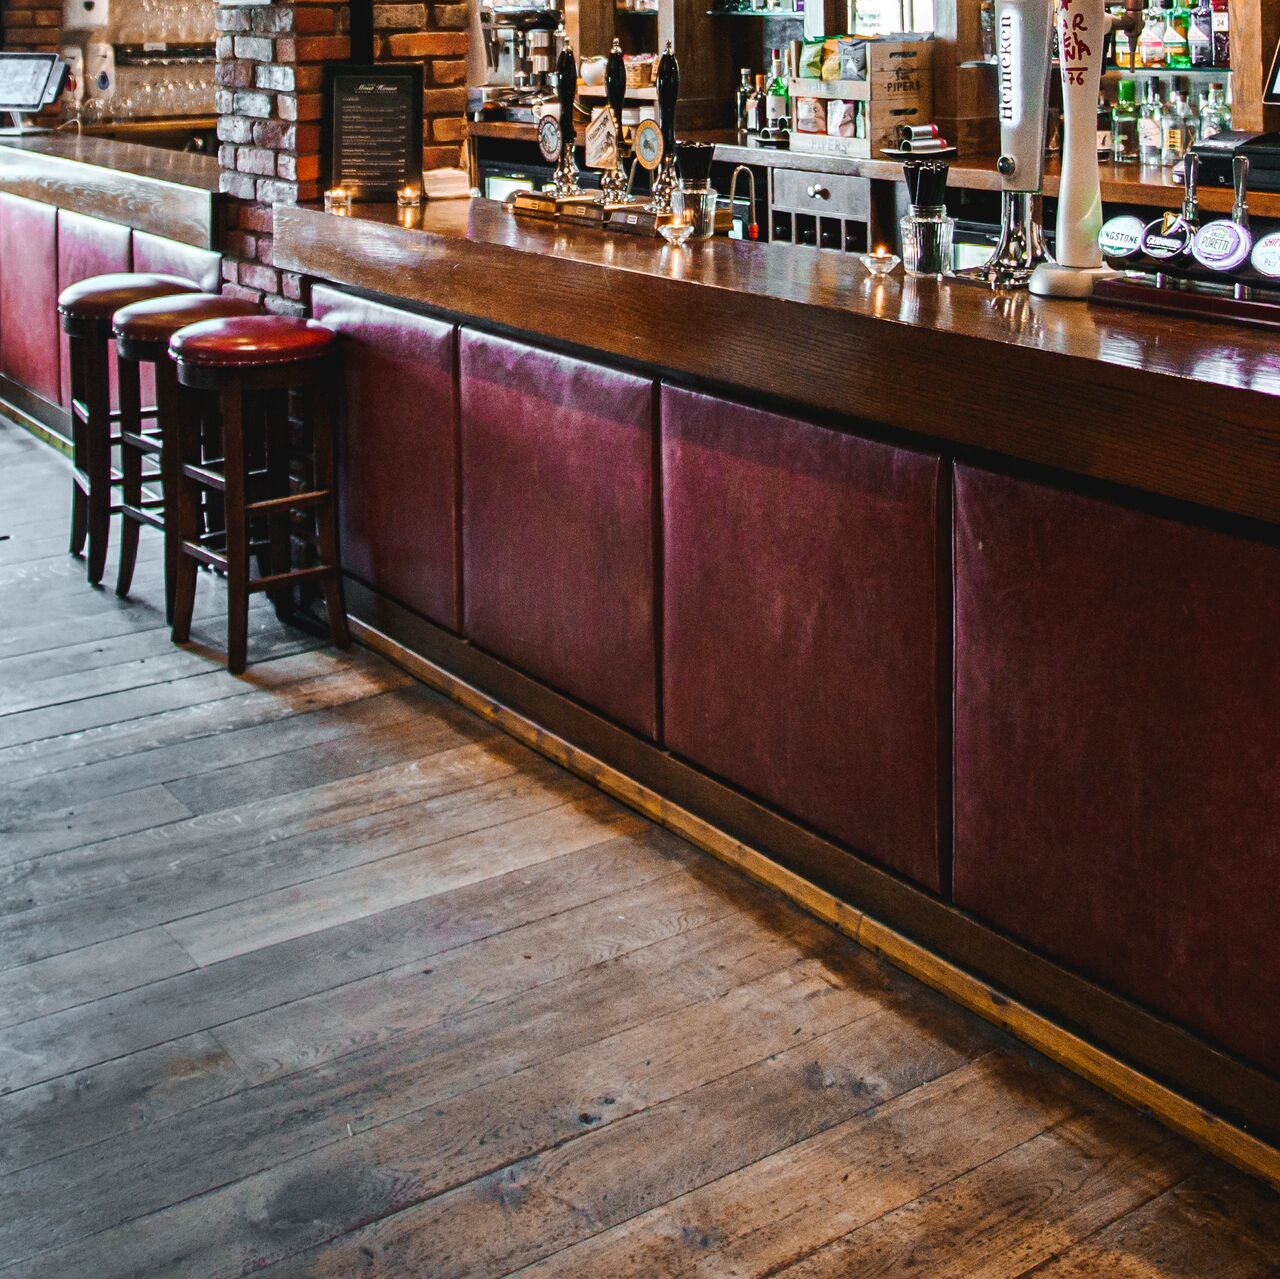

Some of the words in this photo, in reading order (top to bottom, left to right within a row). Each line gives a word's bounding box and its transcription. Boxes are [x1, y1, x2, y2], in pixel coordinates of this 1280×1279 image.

[1216, 19, 1225, 27] 24
[1000, 15, 1013, 121] Heineken
[887, 80, 921, 93] PIPERS
[1200, 236, 1230, 251] PORETTI
